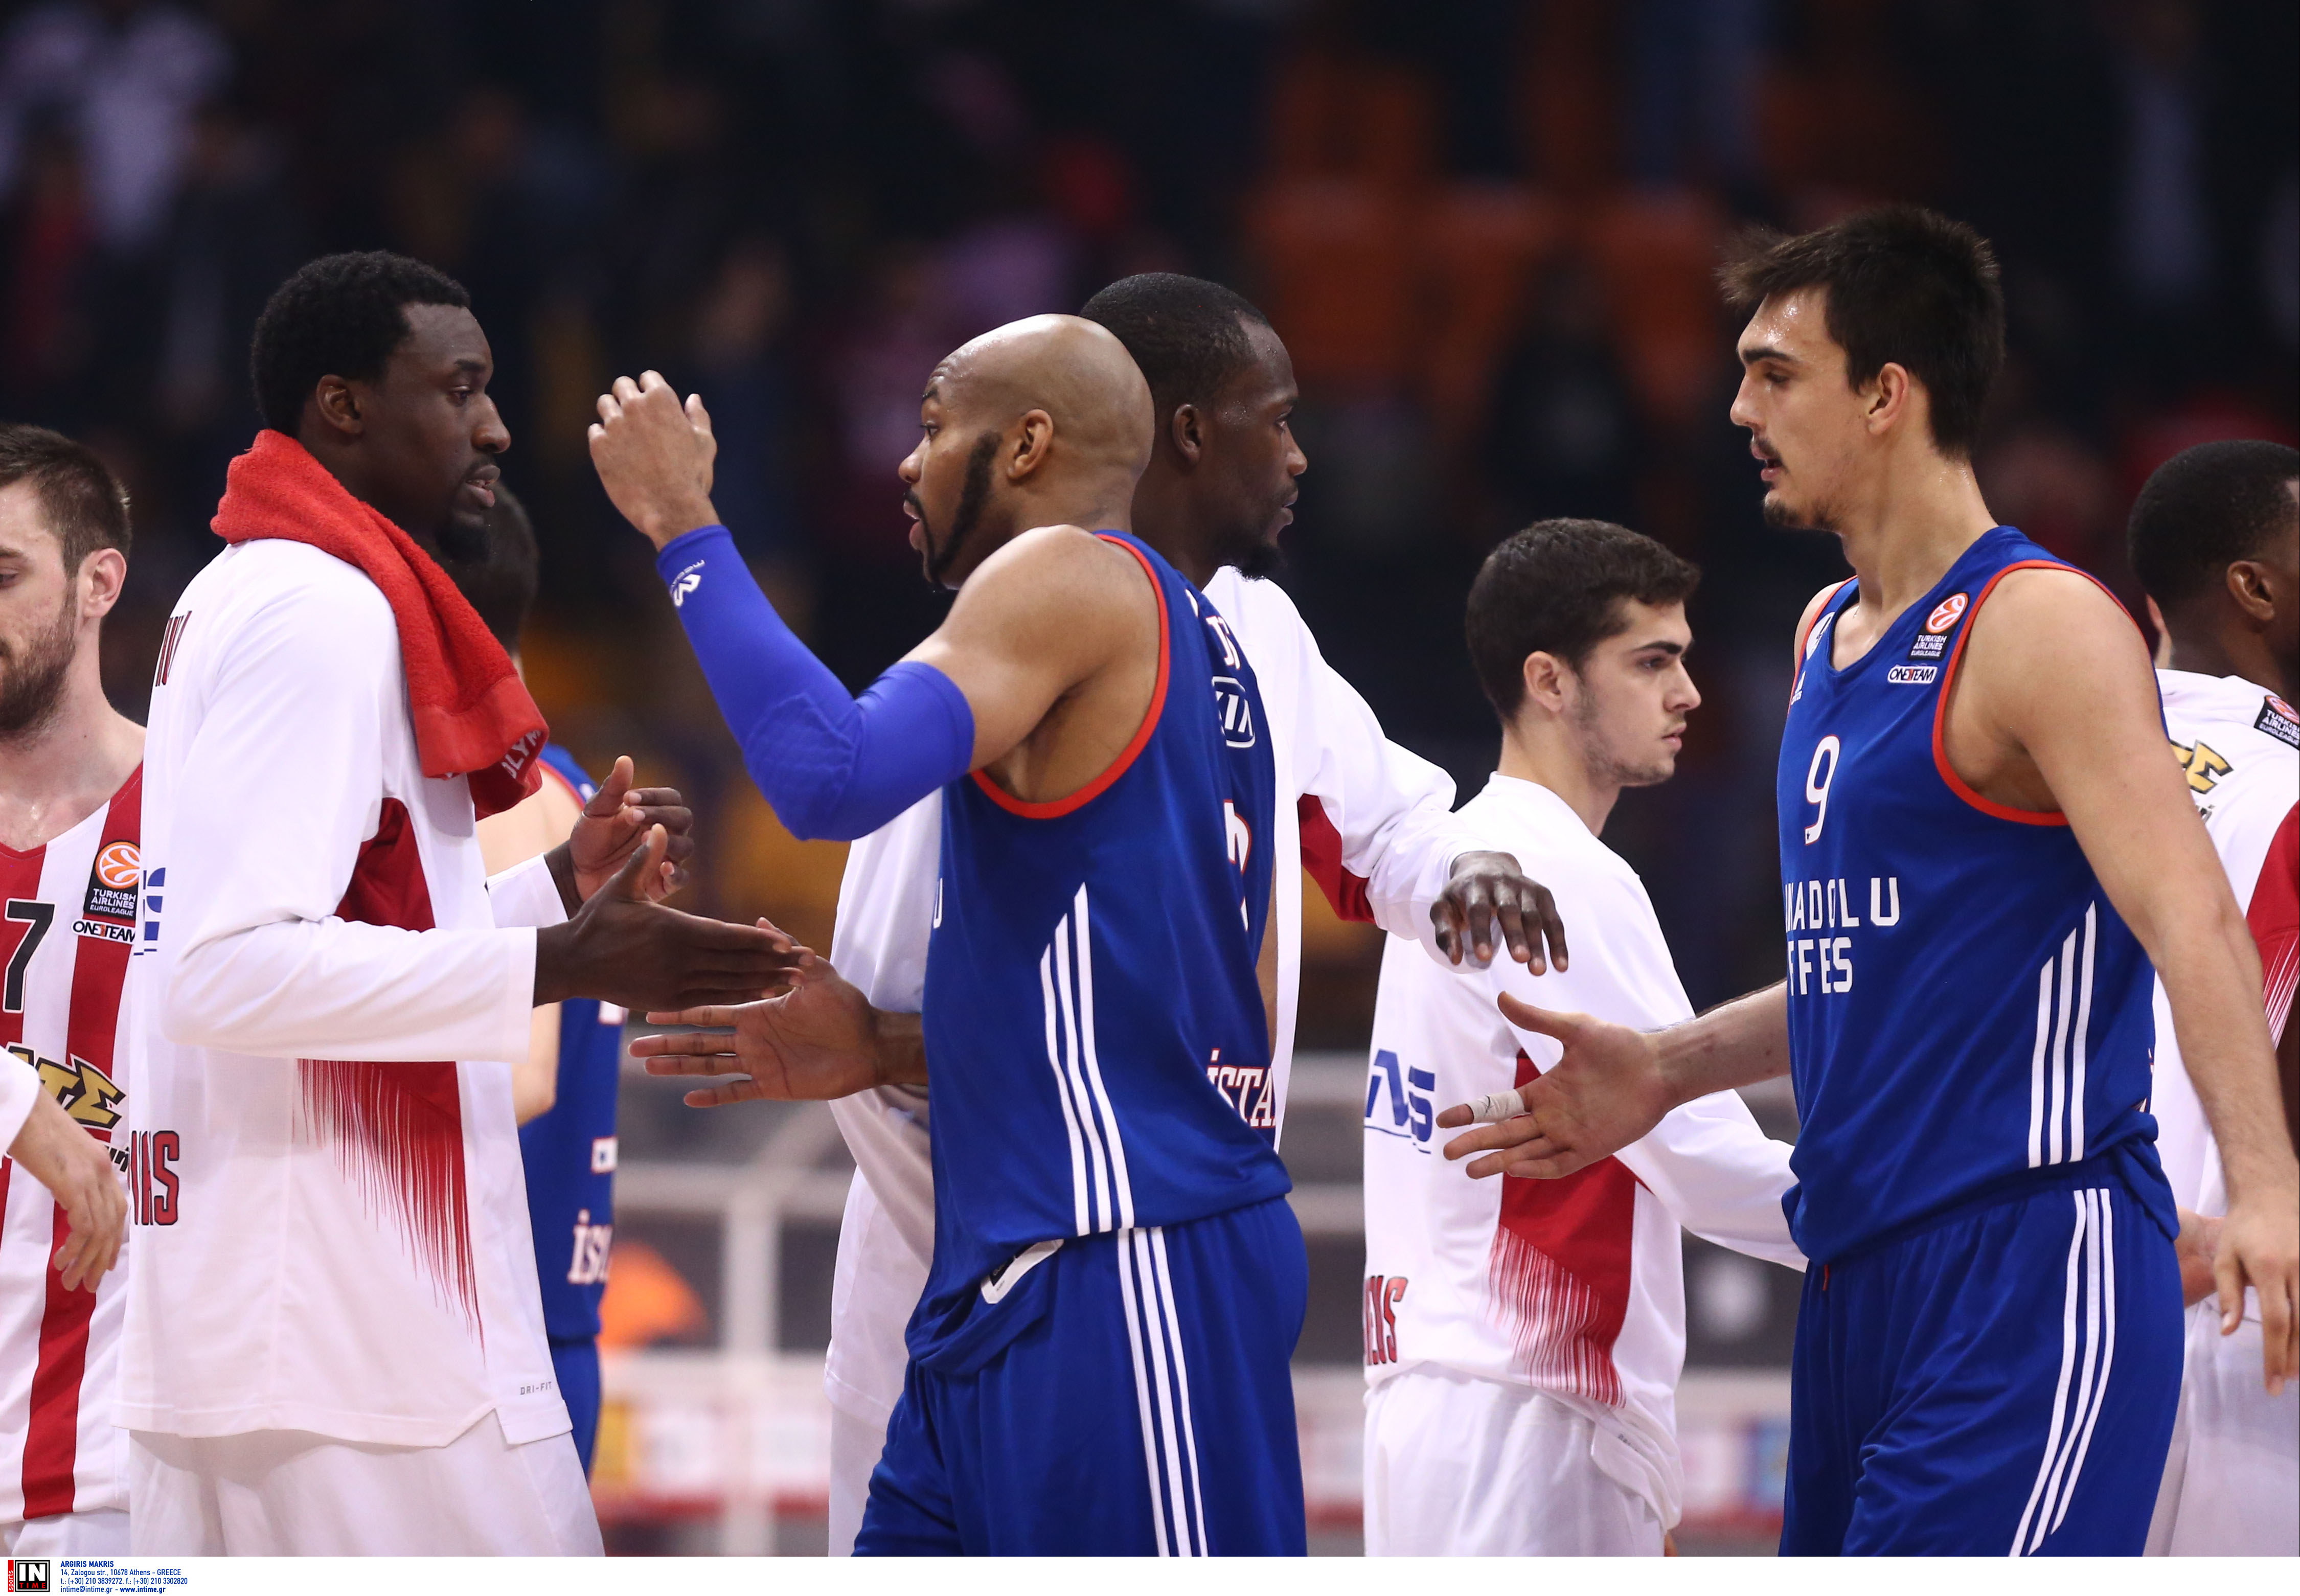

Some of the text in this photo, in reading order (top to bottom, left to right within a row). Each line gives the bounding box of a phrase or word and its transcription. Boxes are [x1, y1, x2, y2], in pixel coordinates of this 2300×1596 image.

[1917, 634, 1948, 644] TURKISH
[1912, 642, 1944, 651] AIRLINES
[1804, 734, 1841, 846] 9
[93, 888, 136, 902] TURKISH
[91, 896, 134, 909] AIRLINES
[1785, 877, 1900, 933] NADOLU
[89, 904, 134, 917] EUROLEAGUE
[5, 898, 55, 1013] 7
[520, 1381, 552, 1396] DRI-FIT
